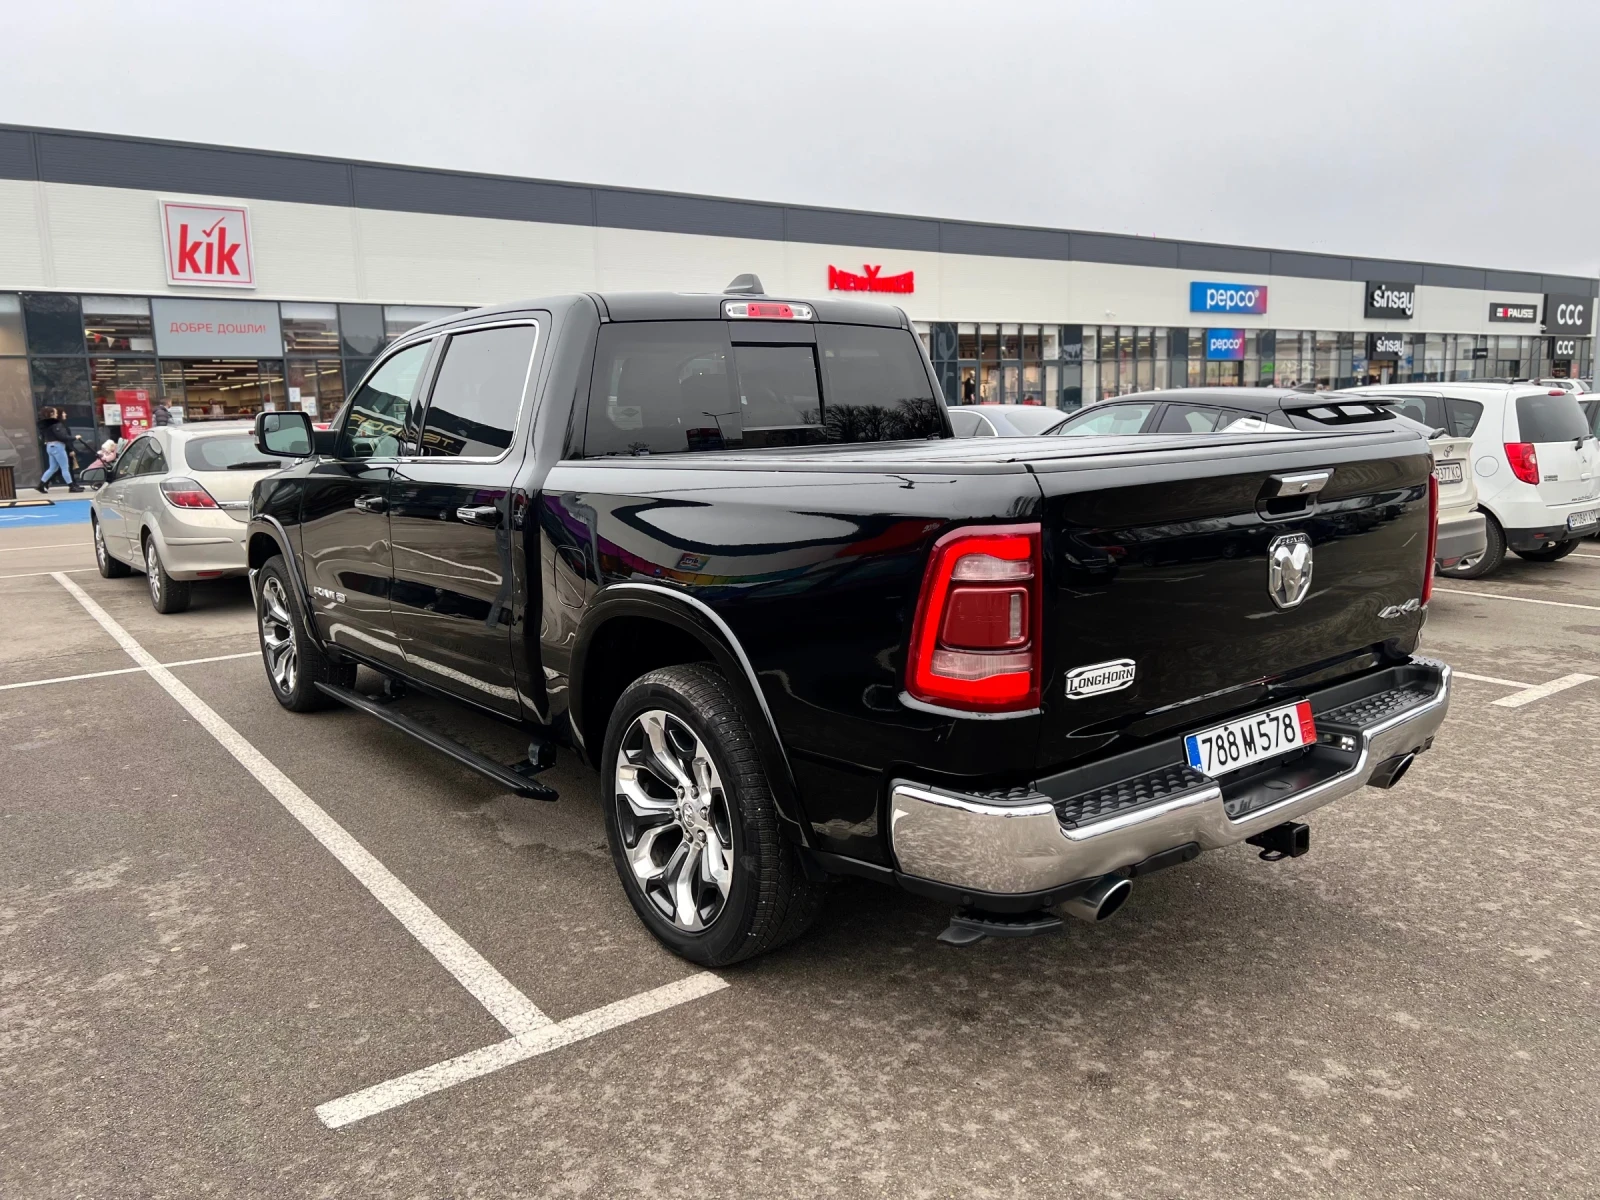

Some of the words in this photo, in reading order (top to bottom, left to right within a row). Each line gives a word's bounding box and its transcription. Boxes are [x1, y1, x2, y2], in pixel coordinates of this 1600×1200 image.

[1206, 288, 1256, 310] pepco
[1373, 284, 1415, 316] sinsay
[1557, 303, 1584, 326] CCC
[170, 322, 214, 334] ДОБРЕ
[217, 323, 266, 335] ДОШЛИ!
[1210, 338, 1240, 352] pepco
[1376, 336, 1405, 356] sinsay
[1556, 340, 1575, 355] CCC
[1068, 667, 1134, 692] LONGHORN
